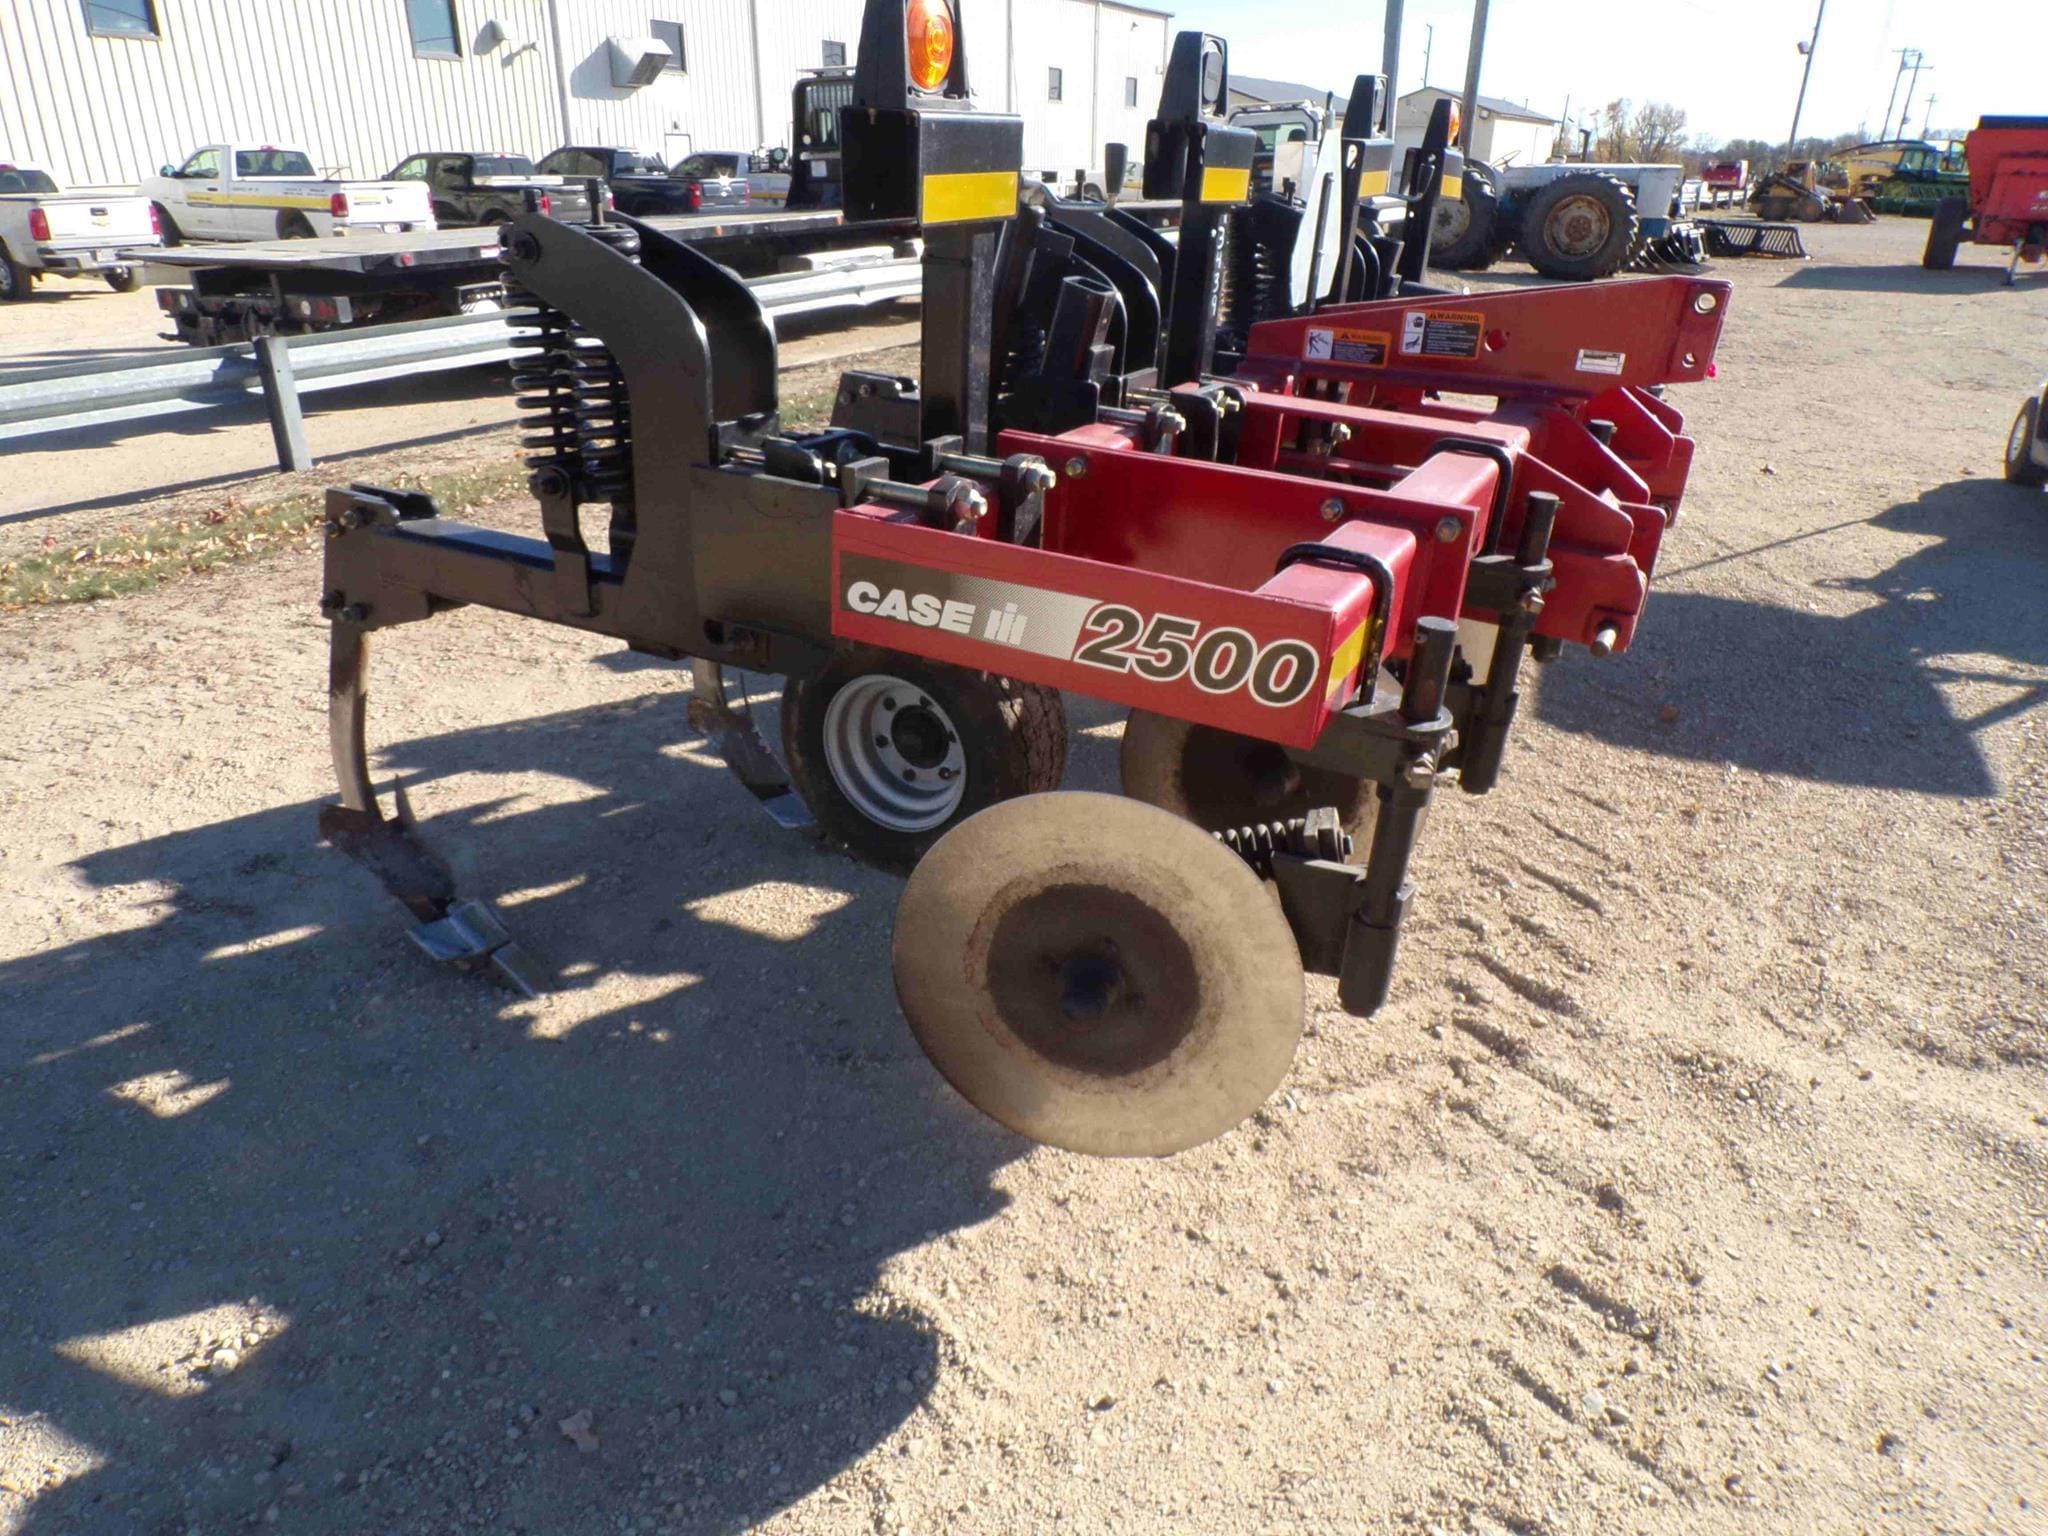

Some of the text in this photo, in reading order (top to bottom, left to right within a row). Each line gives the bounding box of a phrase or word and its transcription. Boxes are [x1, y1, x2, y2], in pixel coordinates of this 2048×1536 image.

[1437, 312, 1480, 322] WARNING
[847, 581, 976, 634] CASE
[1073, 603, 1320, 708] 2500
